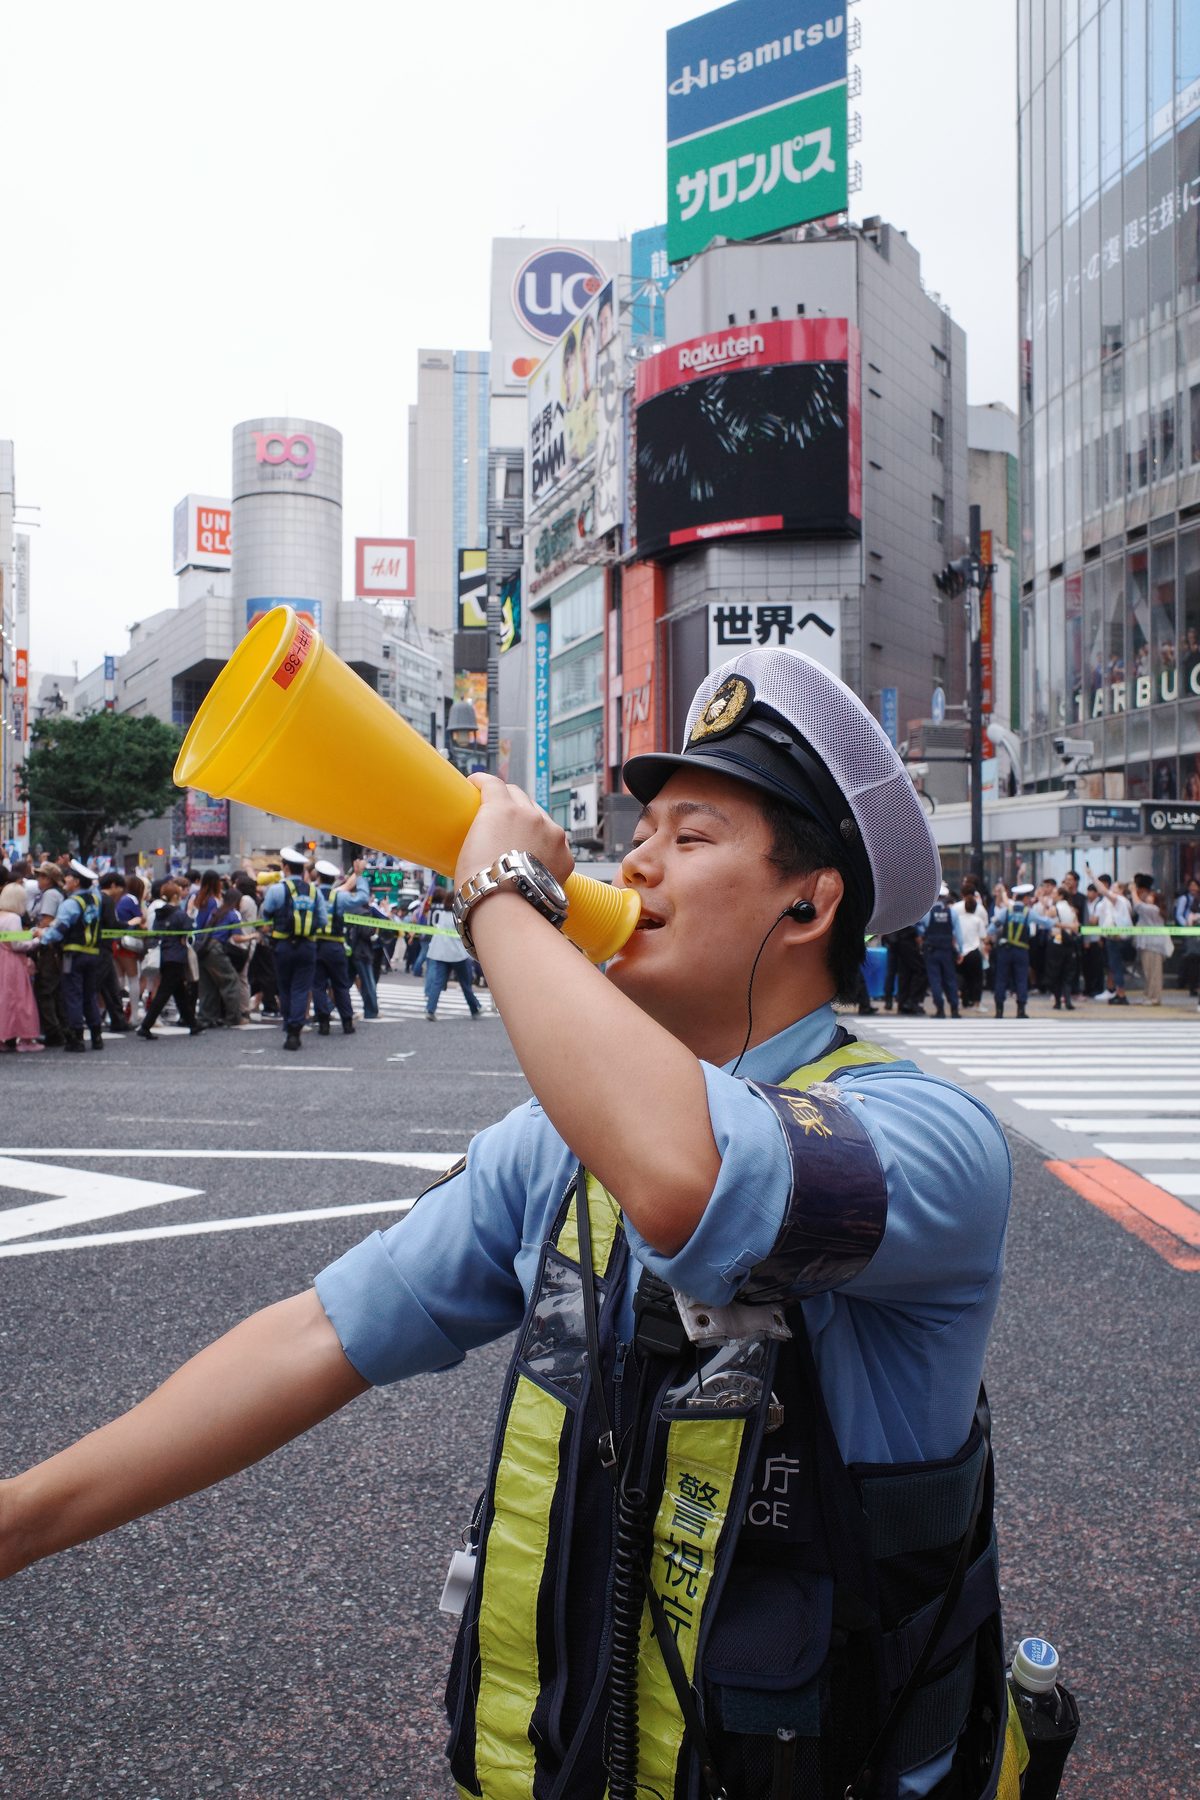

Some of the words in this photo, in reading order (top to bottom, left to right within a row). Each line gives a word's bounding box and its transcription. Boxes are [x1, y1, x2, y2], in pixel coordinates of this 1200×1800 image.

[668, 15, 844, 95] Hisamitsu
[676, 126, 835, 222] サロンパス
[678, 335, 765, 371] Rakuten
[251, 431, 316, 480] 109
[201, 511, 231, 531] UN
[370, 557, 400, 577] H&M
[713, 605, 835, 645] 世界へ
[536, 645, 547, 757] サマーフルーツギフト
[712, 1381, 730, 1393] DL
[734, 1379, 761, 1395] 365
[750, 1453, 799, 1494] 庁
[743, 1501, 789, 1528] CE
[649, 1472, 720, 1638] 警視庁
